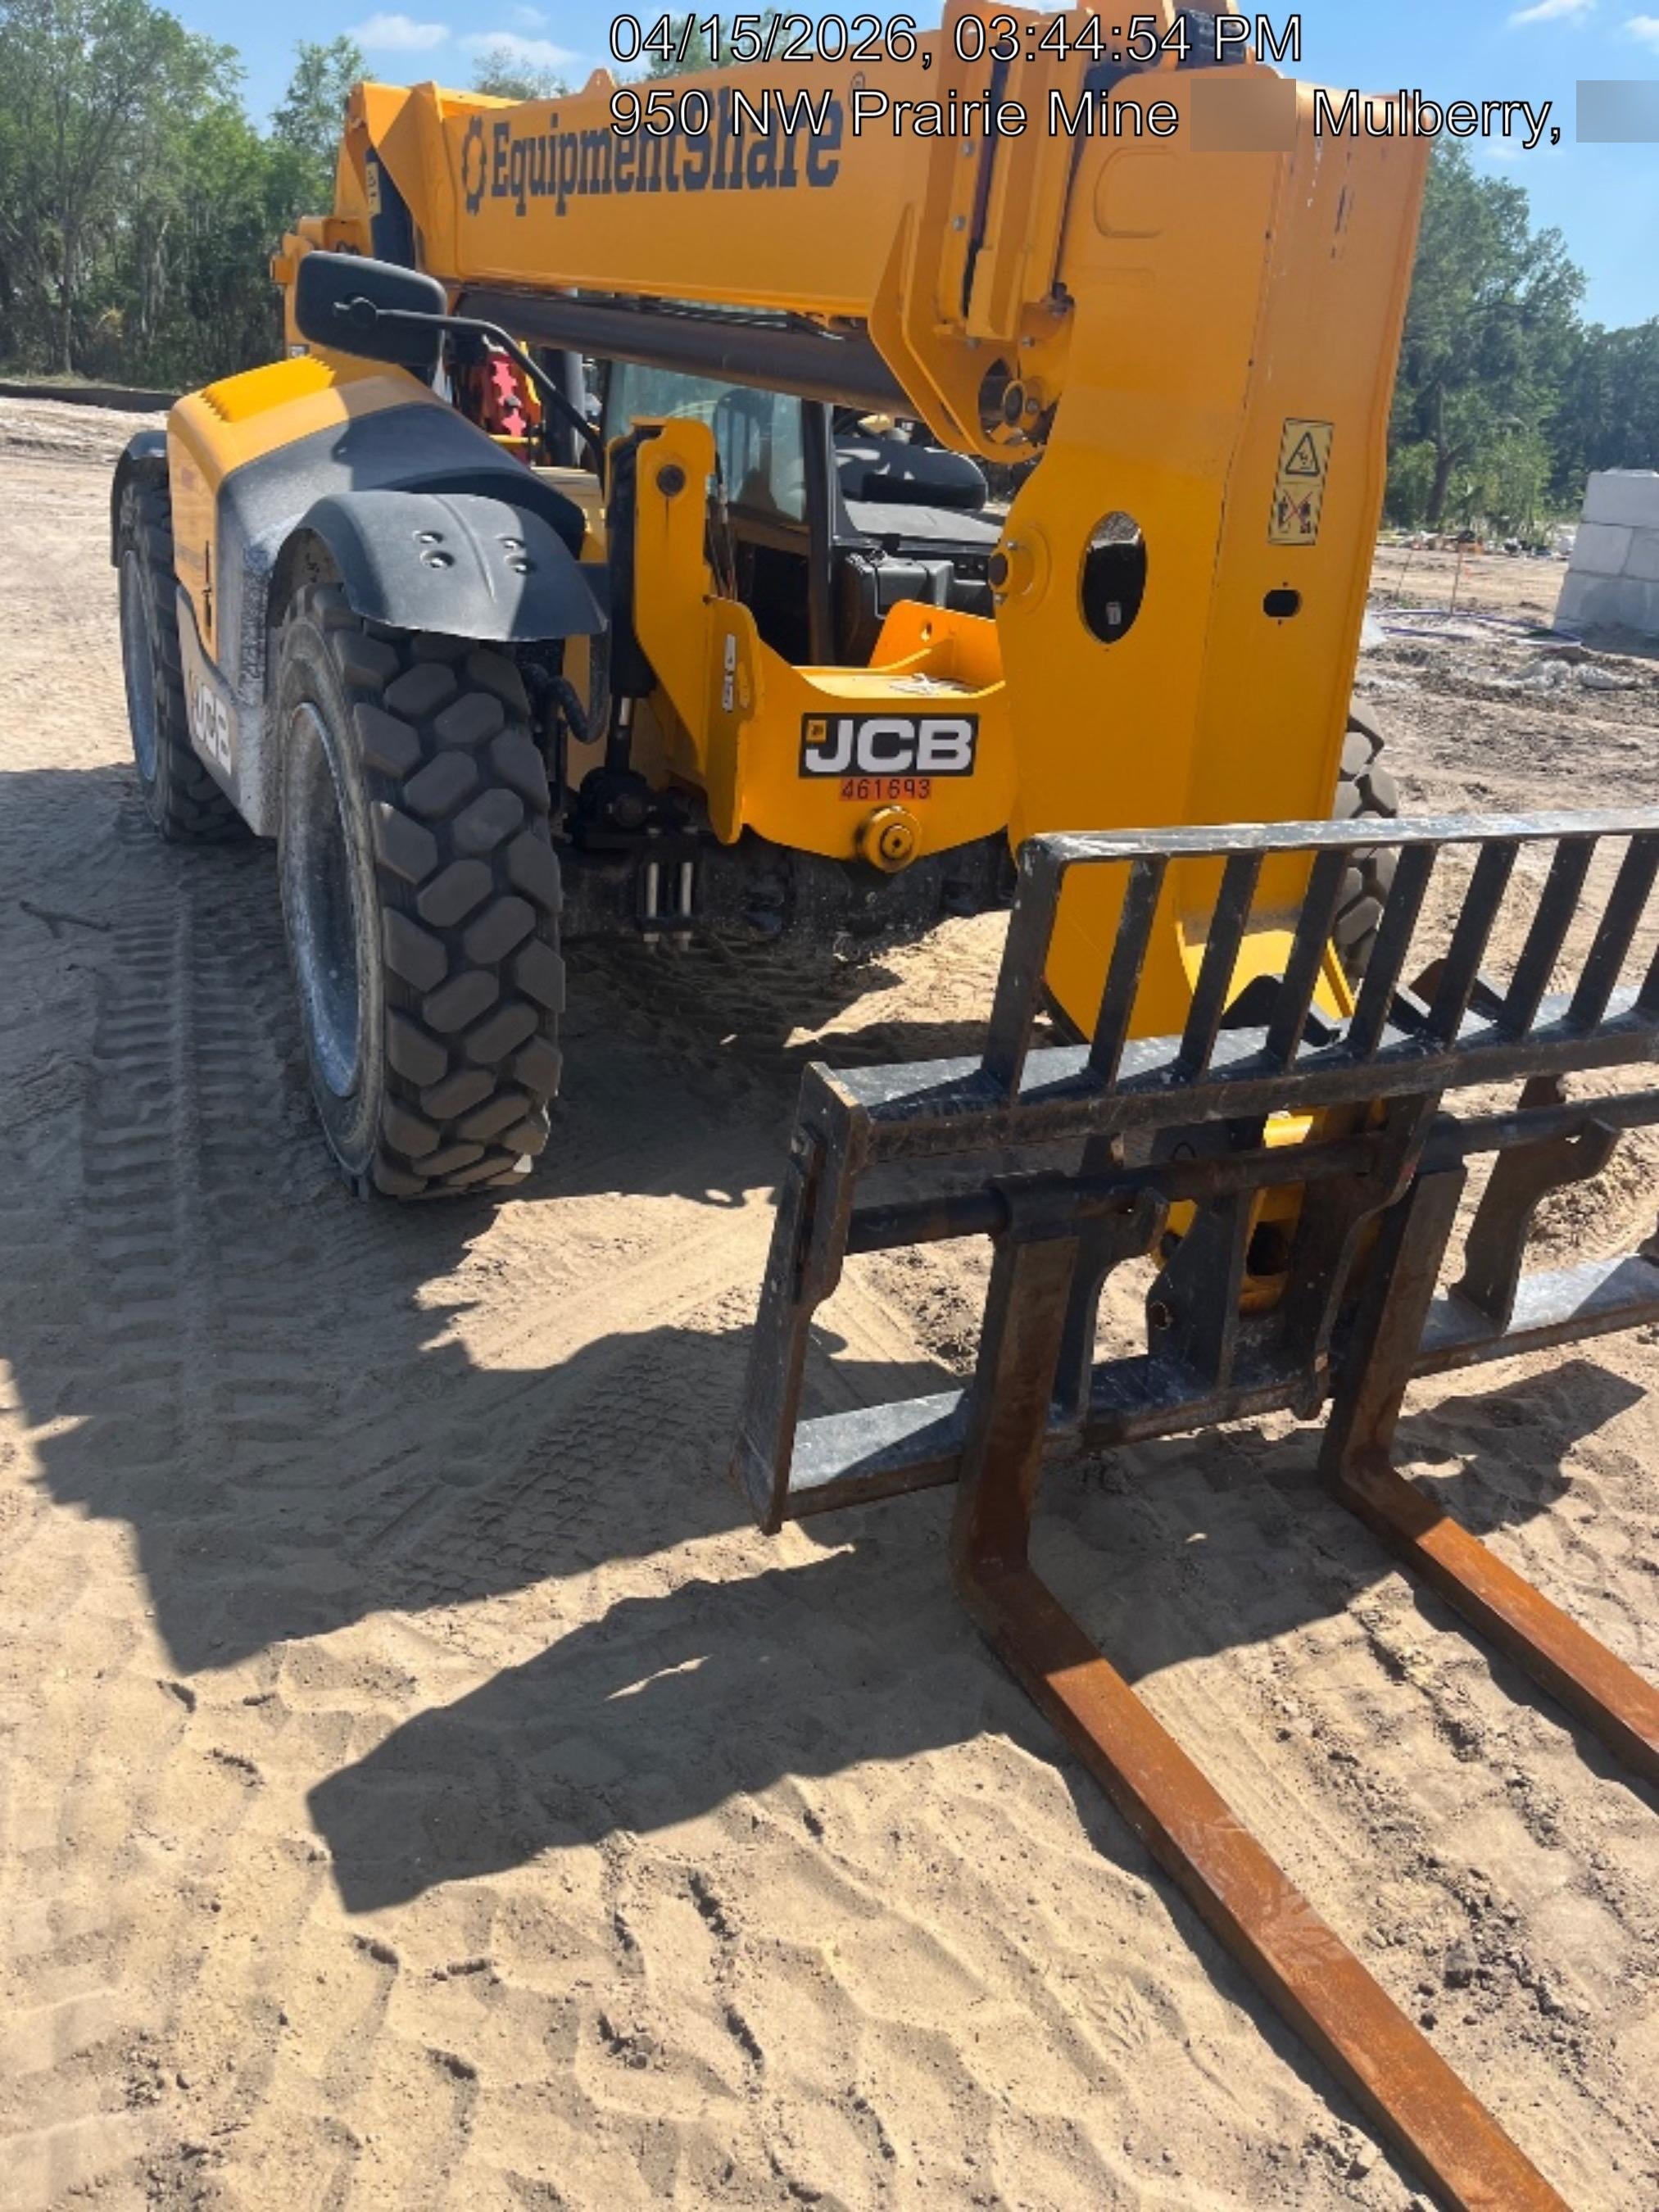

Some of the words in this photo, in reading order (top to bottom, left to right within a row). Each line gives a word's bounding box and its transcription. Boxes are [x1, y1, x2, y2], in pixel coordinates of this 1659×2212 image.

[492, 85, 844, 216] EquipmentShare
[805, 718, 972, 773] JCB
[841, 779, 931, 800] 461693
